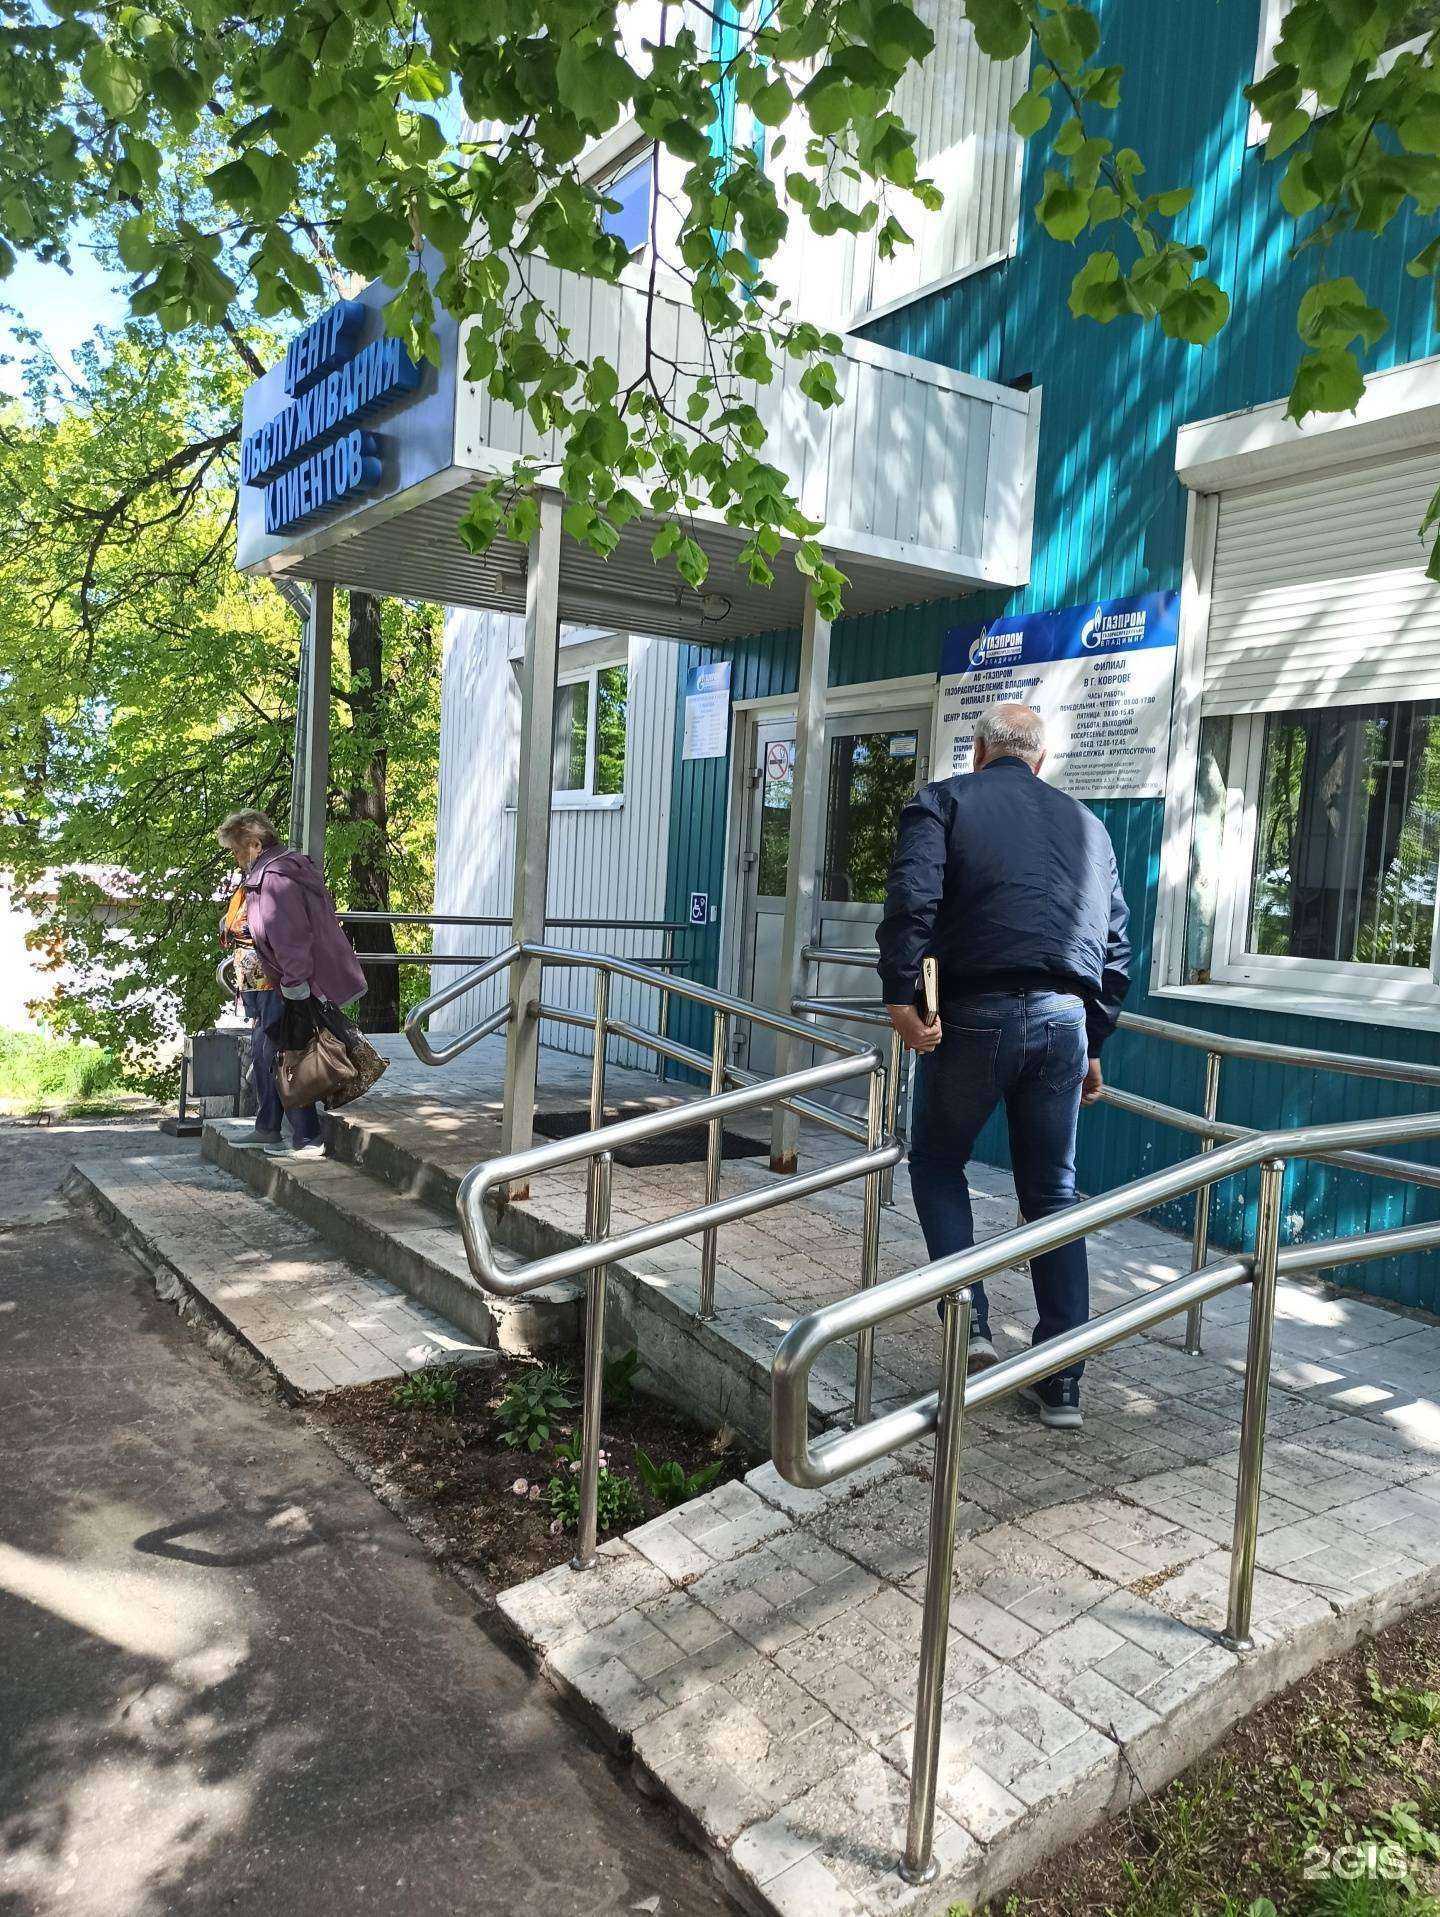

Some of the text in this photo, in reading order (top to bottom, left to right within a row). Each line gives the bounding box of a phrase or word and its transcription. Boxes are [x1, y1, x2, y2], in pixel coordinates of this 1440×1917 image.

[284, 306, 345, 395] ЦЕНТР
[243, 336, 401, 485] ОБСЛУЖИВАНИЯ
[265, 429, 363, 532] КЛИЕНТОВ
[1102, 611, 1147, 630] ГАЗПРОМ
[986, 631, 1023, 650] ГАЗПРОМ
[1100, 635, 1145, 647] ВЛАДИМИР
[1093, 660, 1126, 671] ФИЛИАЛ
[973, 674, 982, 682] АО
[1084, 673, 1131, 687] В Г. КОВРОВЕ
[944, 681, 1004, 697] ГАЗОРАСПРЕДЕЛЕНИЕ
[960, 695, 985, 706] ФИЛИАЛ
[996, 690, 1024, 702] КОВРОВЕ
[1087, 692, 1103, 700] ЧАСЫ
[1060, 703, 1095, 712] ПОНЕДЕЛЬНИК
[943, 711, 961, 723] ЦЕНТР
[1102, 718, 1133, 728] ВЫХОДНОЙ
[1107, 727, 1139, 738] ВЫХОДНОЙ
[1082, 749, 1105, 758] СЛУЖБА
[1109, 746, 1156, 756] КРУГЛОСУТОЧНО
